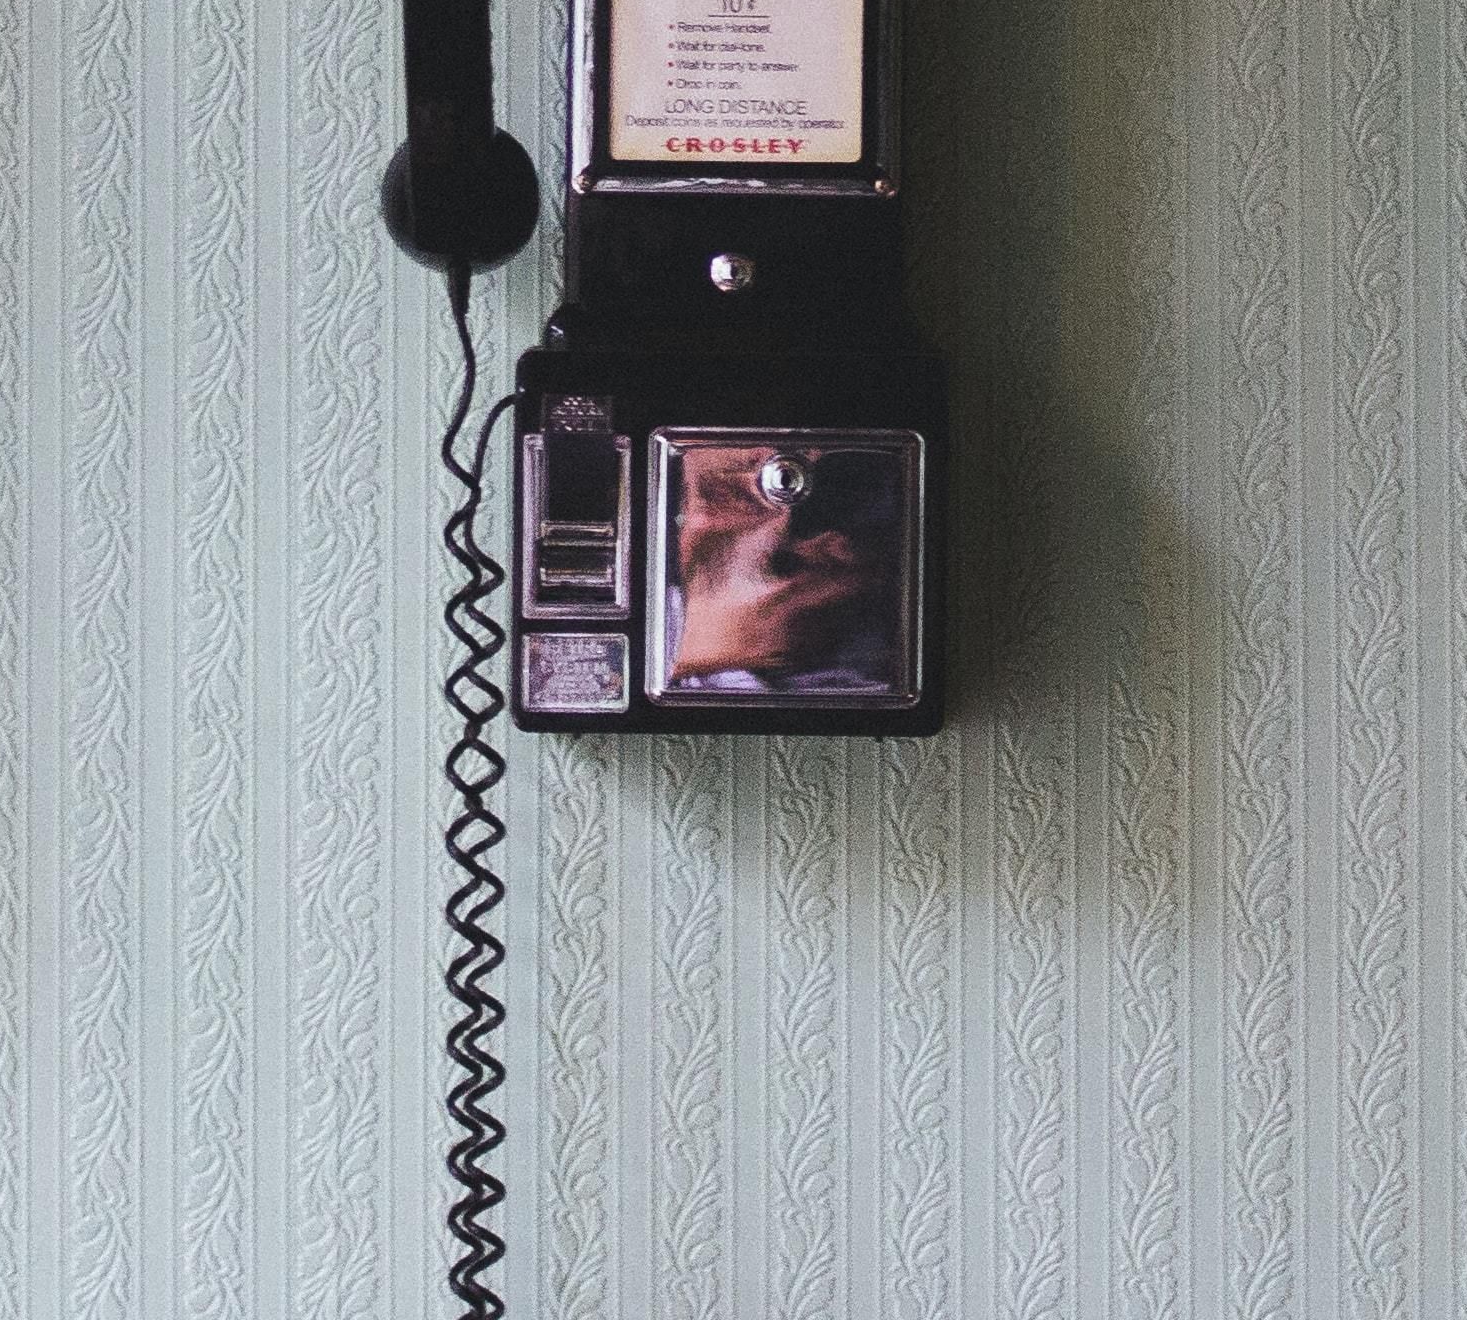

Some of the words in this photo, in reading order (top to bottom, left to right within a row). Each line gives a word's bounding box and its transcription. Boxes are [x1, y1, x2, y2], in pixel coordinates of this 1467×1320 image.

[677, 22, 723, 33] Remove
[677, 41, 700, 52] Wait
[702, 41, 716, 52] for
[676, 60, 700, 70] Wait
[702, 60, 716, 70] for
[718, 61, 745, 73] party
[747, 61, 759, 71] to
[676, 78, 704, 90] Drop
[706, 78, 716, 89] in
[664, 98, 714, 114] LONG
[718, 99, 809, 115] DISTANCE
[624, 115, 672, 128] Deposit
[673, 117, 701, 128] coins
[704, 118, 718, 128] as
[722, 117, 780, 129] requested
[781, 117, 795, 130] by
[665, 137, 804, 155] CROSLEY
